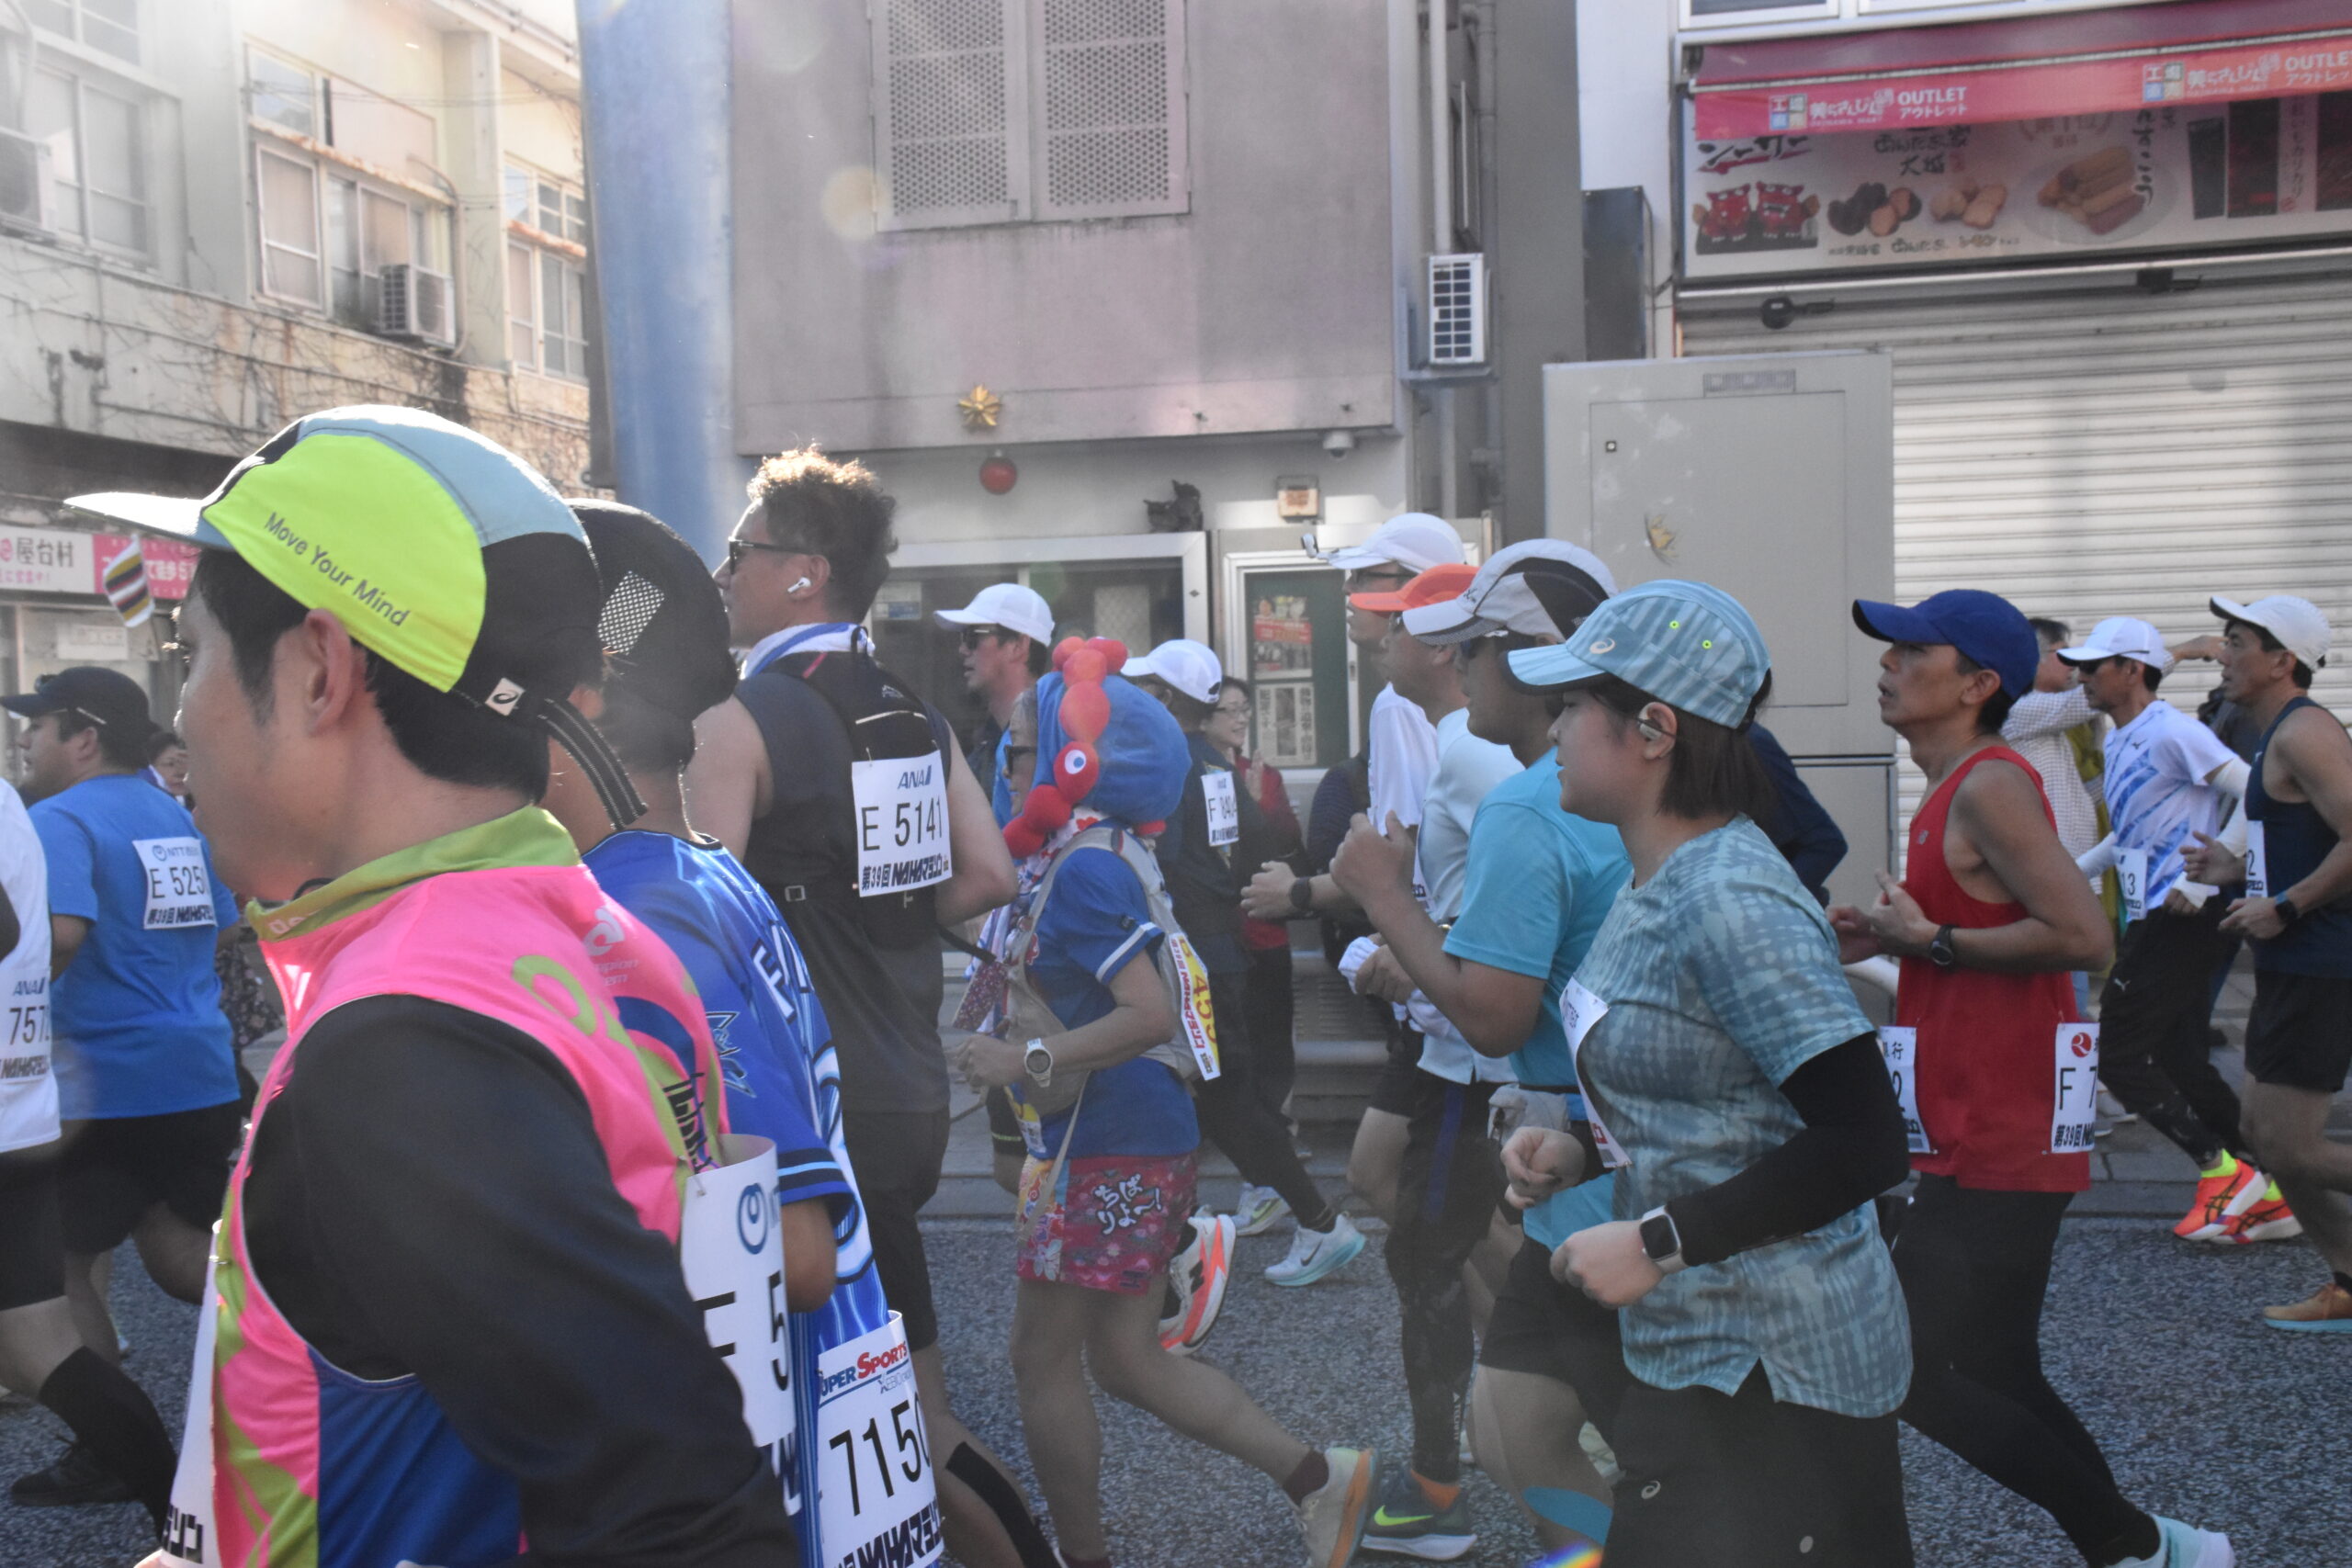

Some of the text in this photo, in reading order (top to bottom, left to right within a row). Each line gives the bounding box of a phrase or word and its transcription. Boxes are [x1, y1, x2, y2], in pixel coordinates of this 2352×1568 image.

[2287, 68, 2352, 85] アウトレッ
[1898, 86, 1967, 106] OUTLET
[1900, 102, 1967, 119] アウトレット
[17, 536, 74, 569] 屋台村
[265, 512, 412, 626] Move Your Mind
[898, 768, 927, 790] ANA
[862, 795, 943, 852] E 5141
[150, 868, 165, 899] E
[2059, 1066, 2076, 1111] F
[820, 1366, 857, 1397] UPER
